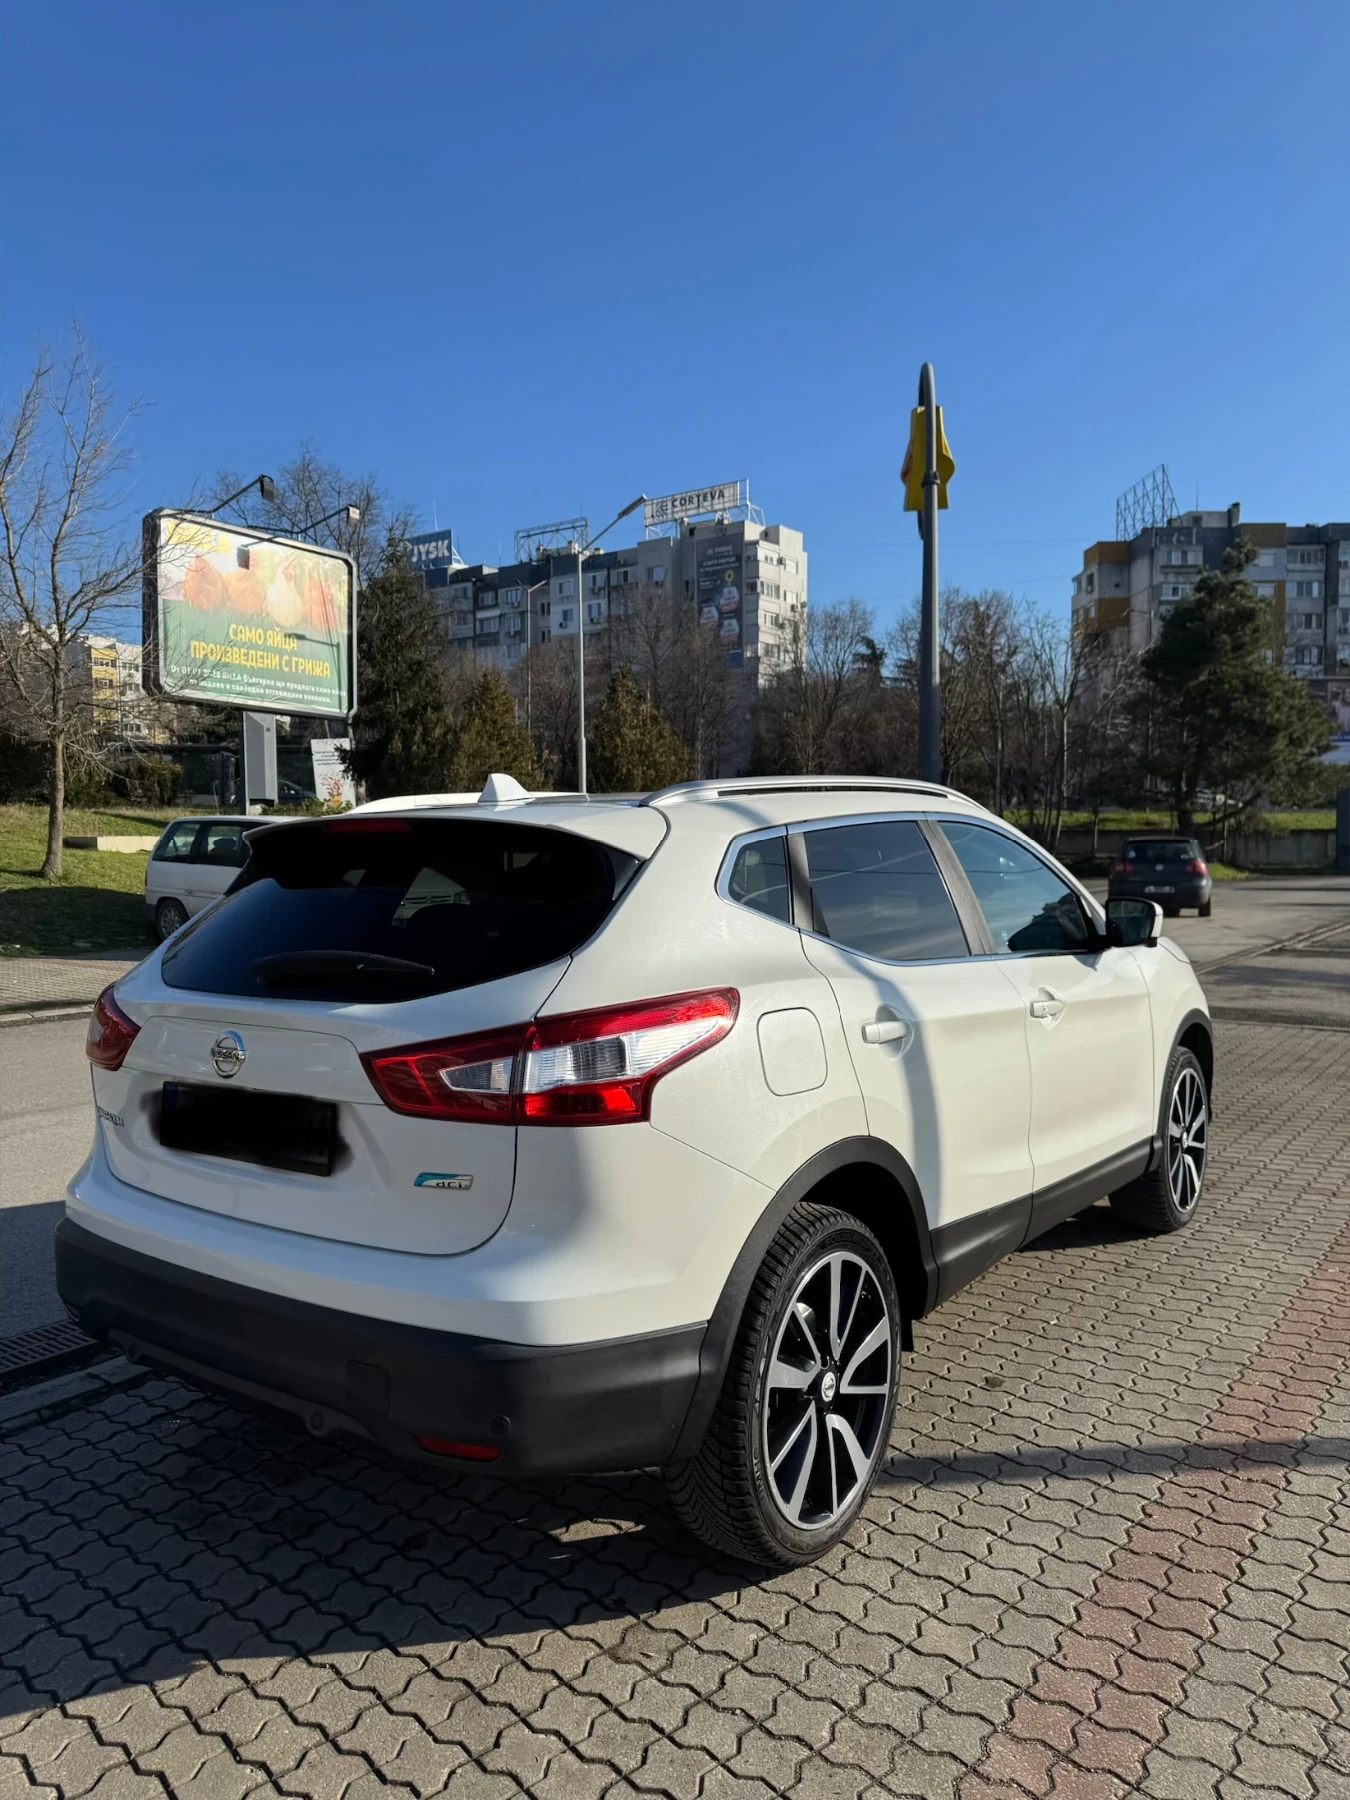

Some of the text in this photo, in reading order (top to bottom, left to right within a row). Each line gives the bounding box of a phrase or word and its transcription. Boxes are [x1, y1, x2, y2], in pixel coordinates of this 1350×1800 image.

[671, 489, 725, 508] CORTEVA
[411, 540, 450, 562] JYSK
[229, 623, 298, 652] САМО ЯЙЦА
[190, 640, 331, 678] ПРОИЗВЕДЕНИ С ГРИЖА
[212, 1048, 241, 1061] SSAN
